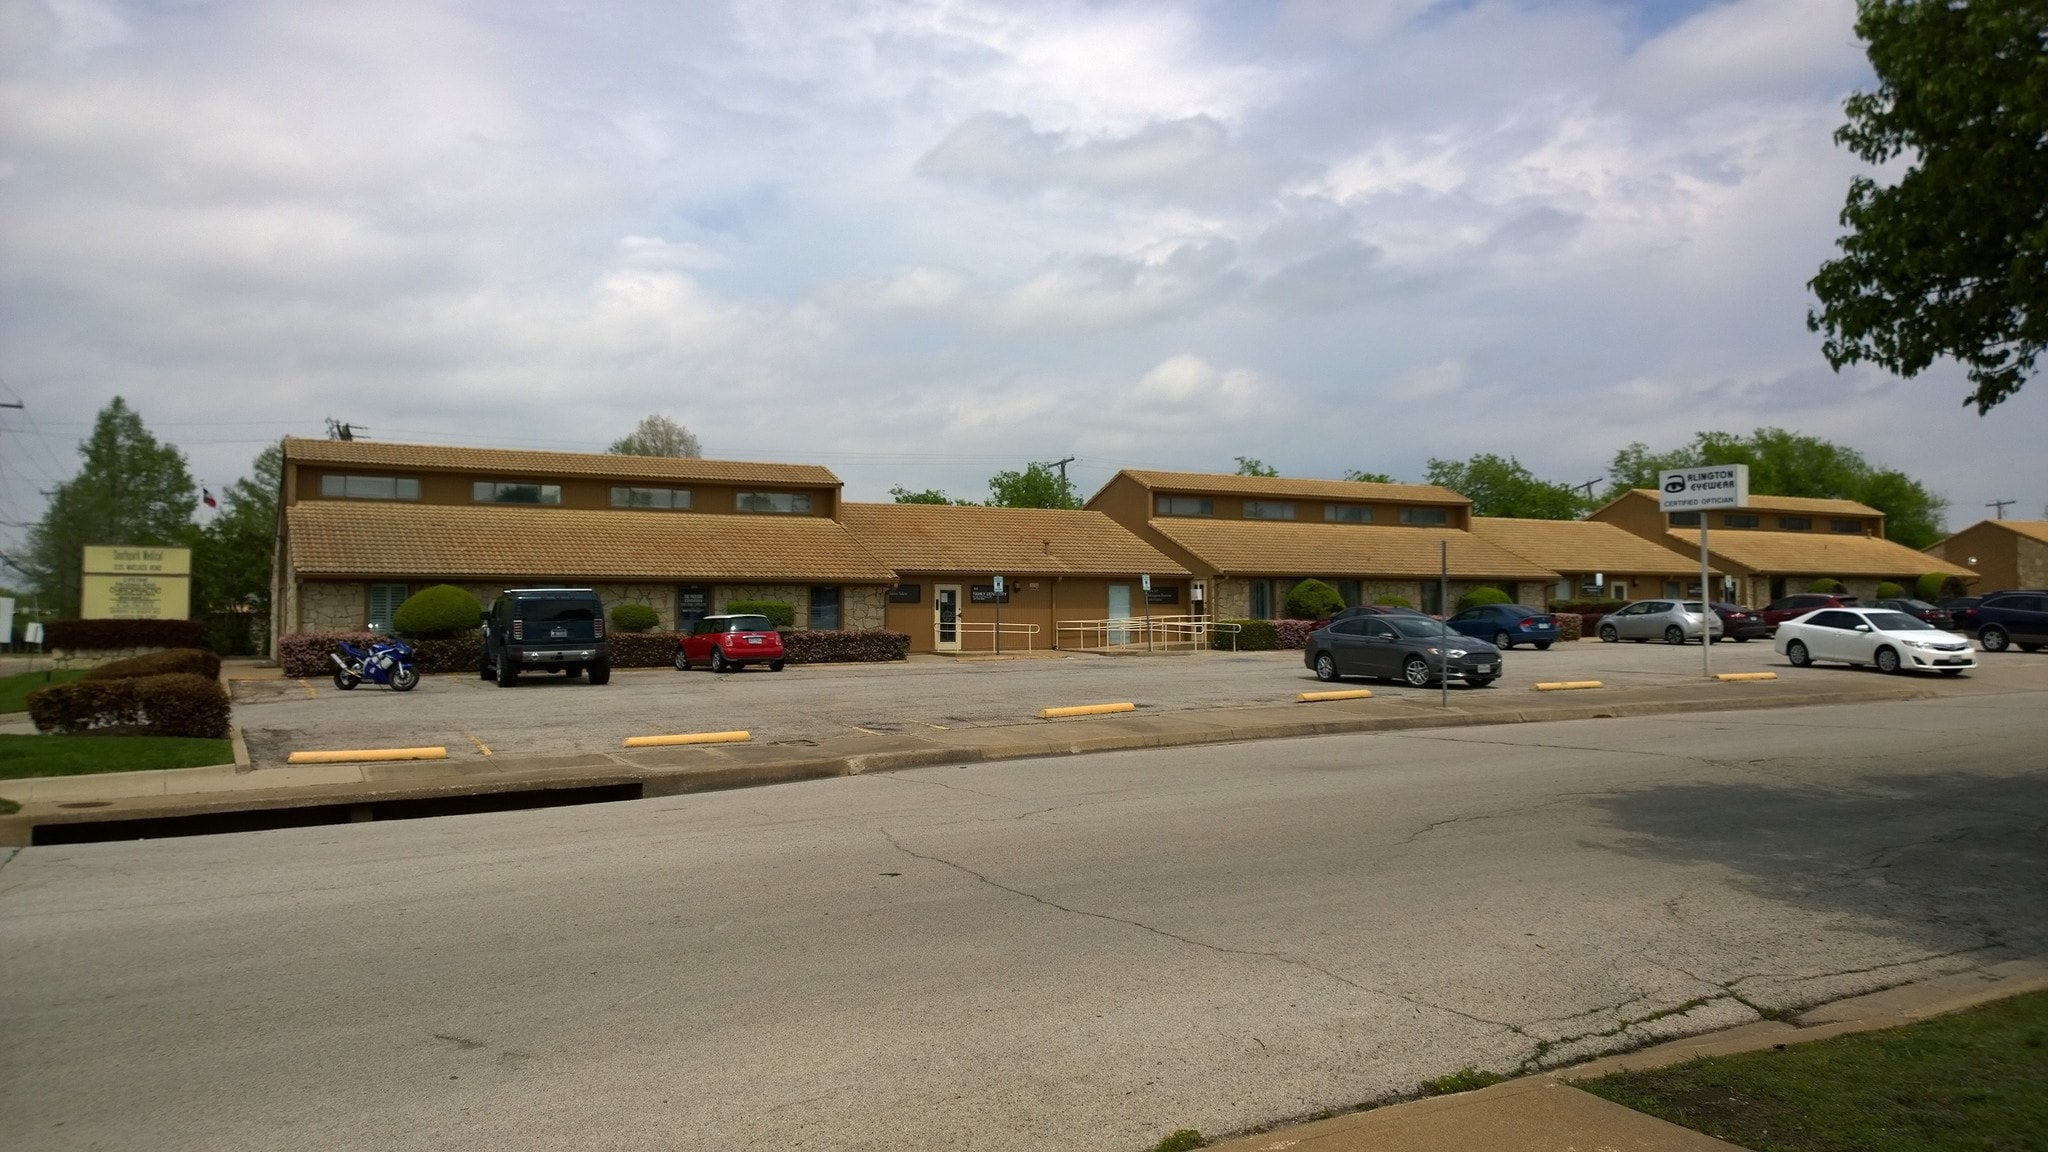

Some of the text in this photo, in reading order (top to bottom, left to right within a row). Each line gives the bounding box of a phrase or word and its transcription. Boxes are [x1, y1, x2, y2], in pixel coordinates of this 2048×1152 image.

[1691, 481, 1735, 491] EYEWEAR
[1664, 497, 1734, 507] CERTIFIED OPTICIAN
